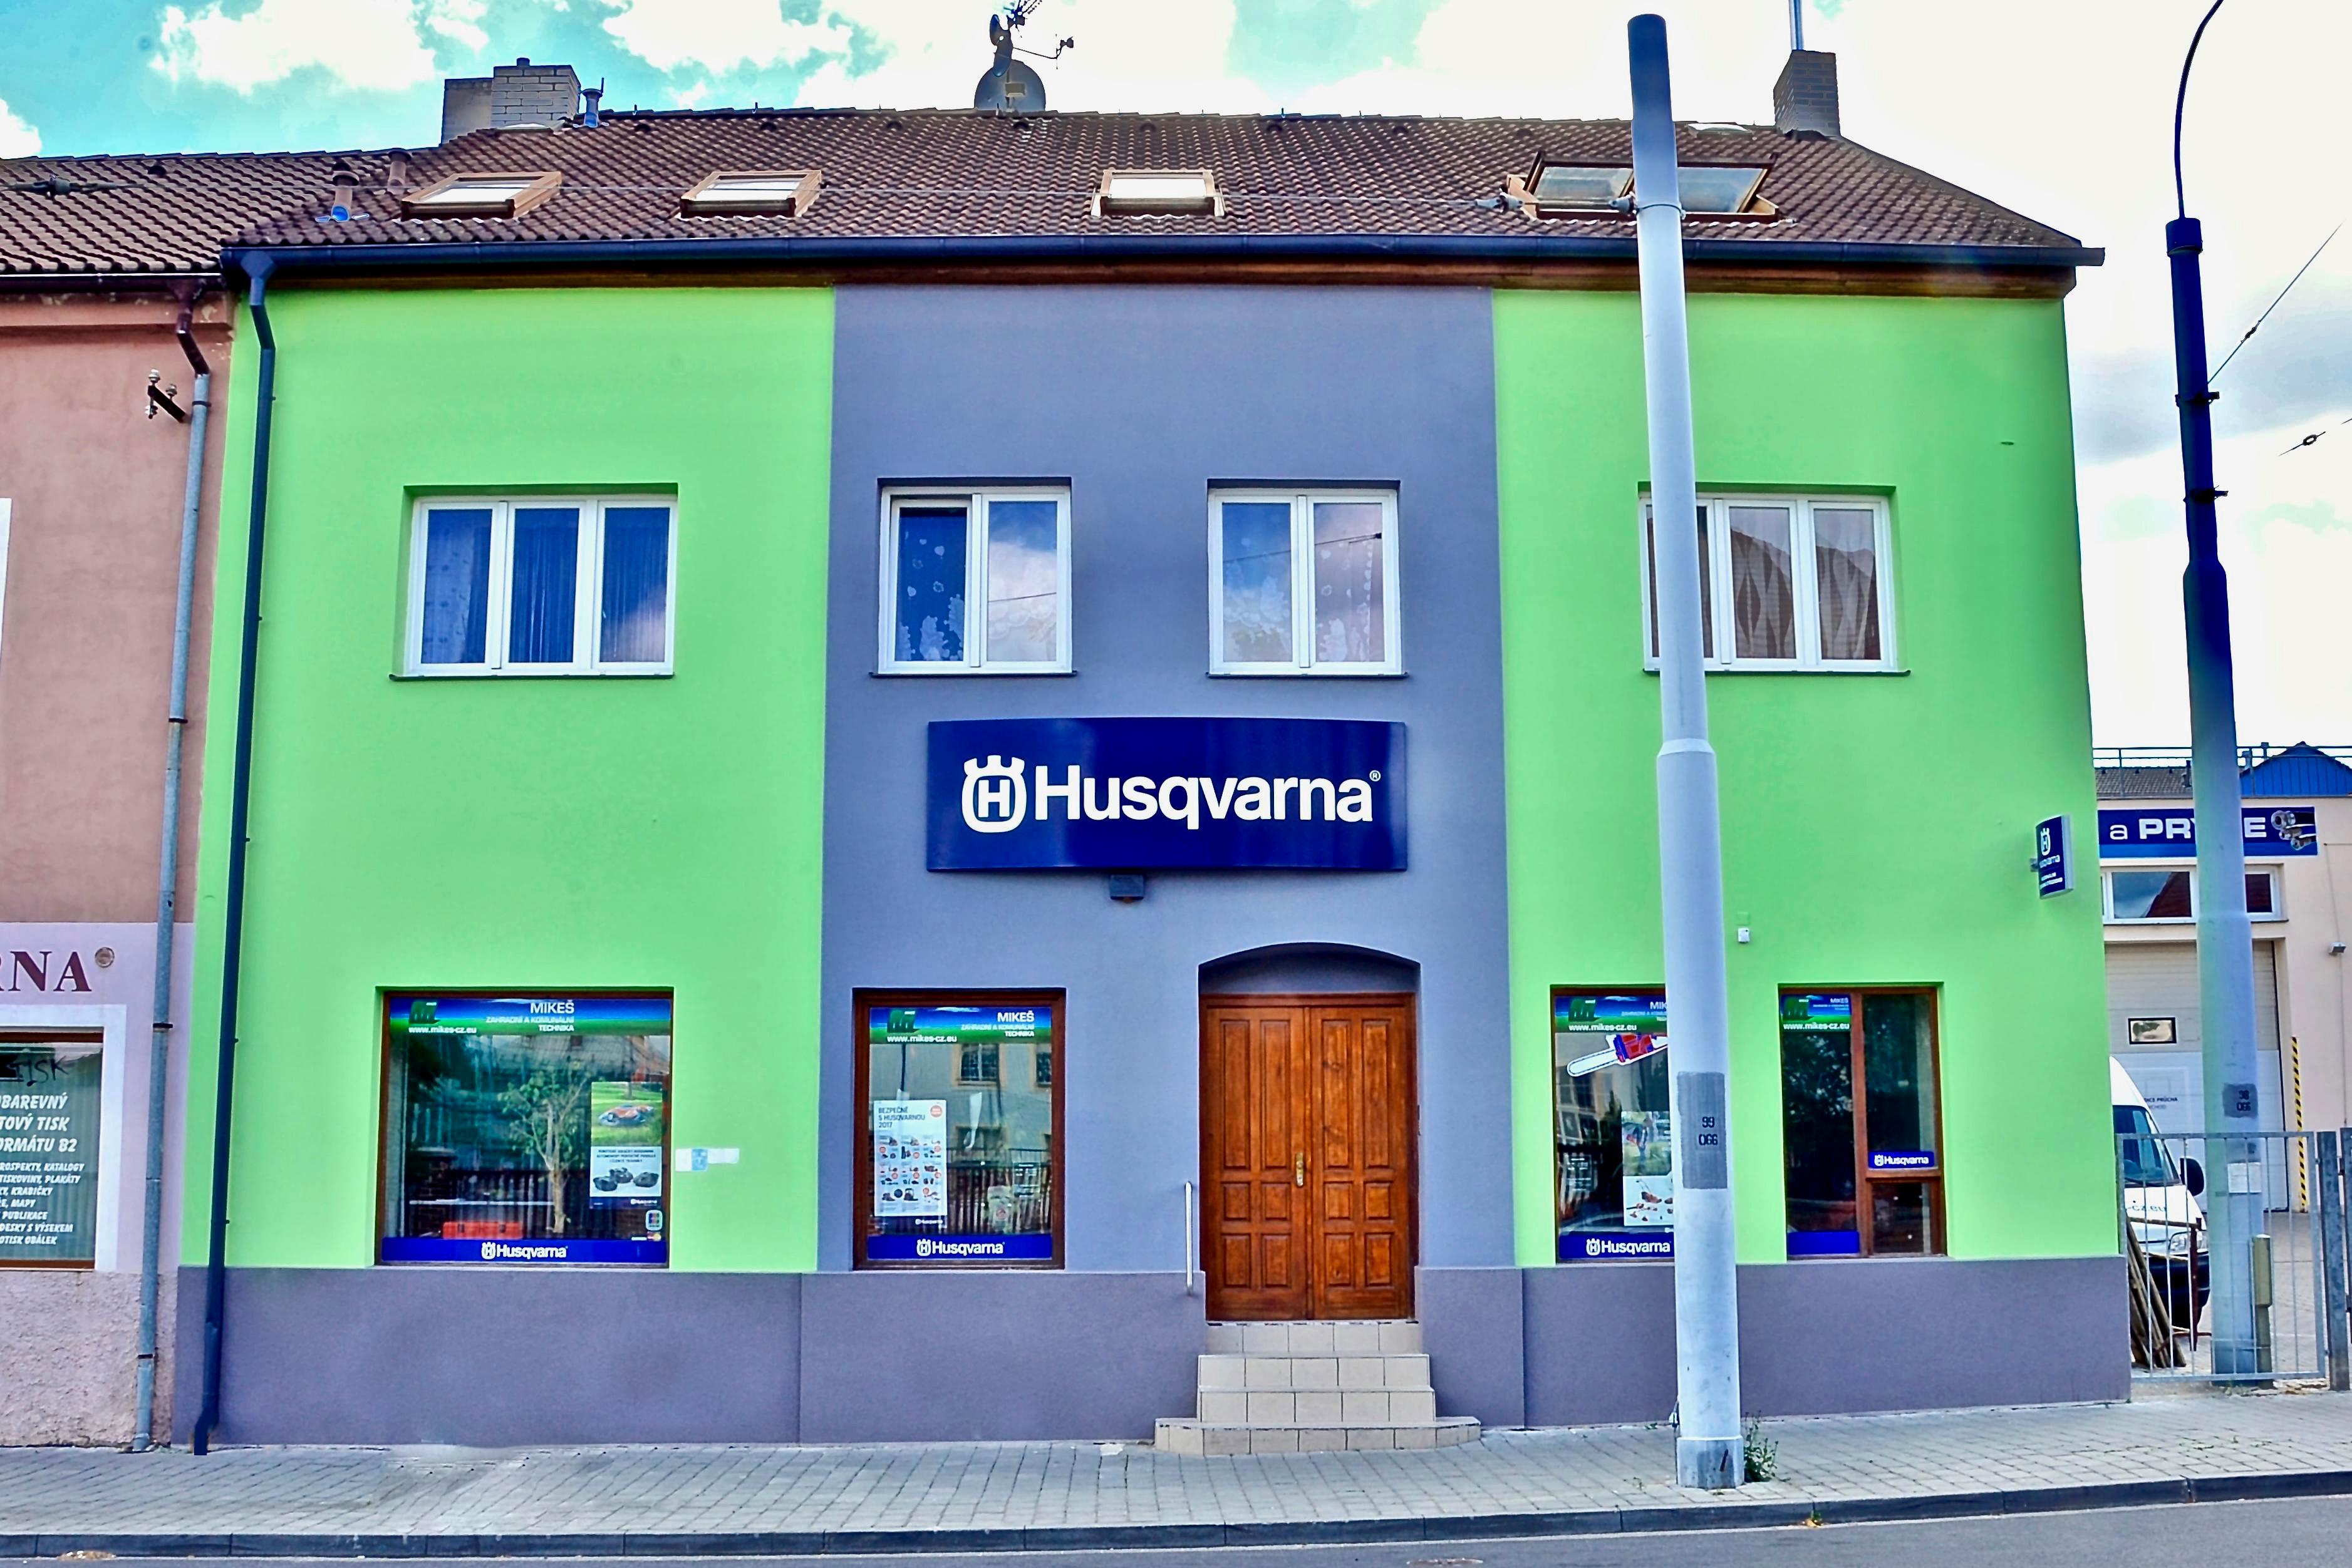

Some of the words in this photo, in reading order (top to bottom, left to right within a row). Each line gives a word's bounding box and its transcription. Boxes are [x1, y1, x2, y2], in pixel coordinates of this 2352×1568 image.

[2110, 824, 2128, 840] a
[2138, 817, 2267, 840] PRE
[0, 951, 92, 992] NA
[531, 999, 574, 1014] MIKEŠ
[997, 1010, 1035, 1022] MIKEŠ
[887, 1034, 957, 1043] www.mikes-cz.eu
[0, 1092, 68, 1110] BAREVNÝ
[37, 1117, 70, 1132] TISK
[1702, 1117, 1715, 1128] 99
[58, 1138, 78, 1152] B2
[1699, 1133, 1718, 1145] 066
[1884, 1155, 1929, 1165] Husqvarna
[44, 1163, 85, 1172] KATALOGY
[44, 1173, 81, 1184] PLAKÁTY
[11, 1185, 53, 1196] KRABIČKY
[11, 1199, 36, 1208] MAPY
[2, 1211, 48, 1220] PUBLIKACE
[34, 1222, 73, 1232] VÝSEKEM
[25, 1234, 58, 1245] OBÁLEK
[496, 1244, 567, 1259] Husqvarna
[932, 1240, 1003, 1256] Husqvarna
[1601, 1240, 1671, 1255] Husqvarna
